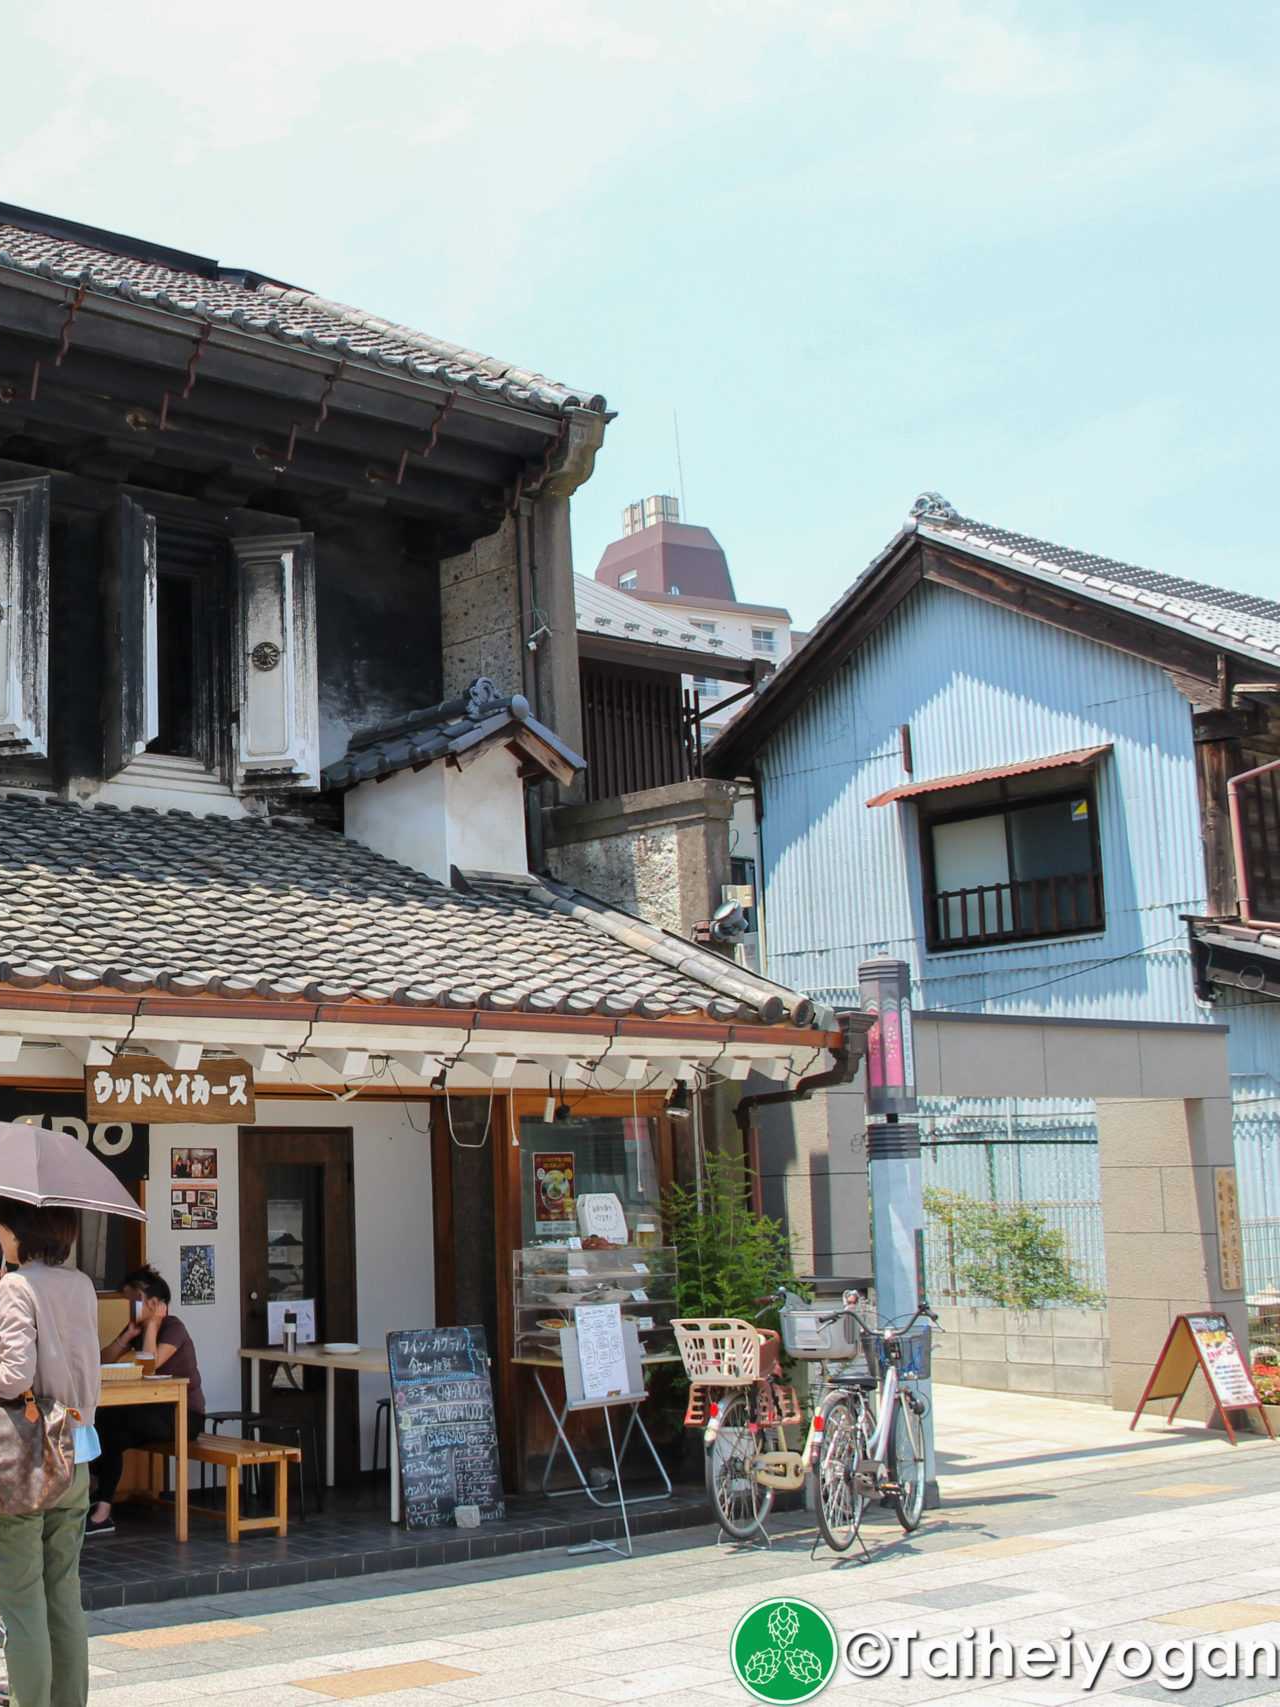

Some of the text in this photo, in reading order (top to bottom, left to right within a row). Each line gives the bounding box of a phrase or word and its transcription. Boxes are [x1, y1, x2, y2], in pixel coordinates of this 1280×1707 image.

[93, 1071, 248, 1106] ウッドベイカーズ
[426, 1431, 466, 1449] MENU
